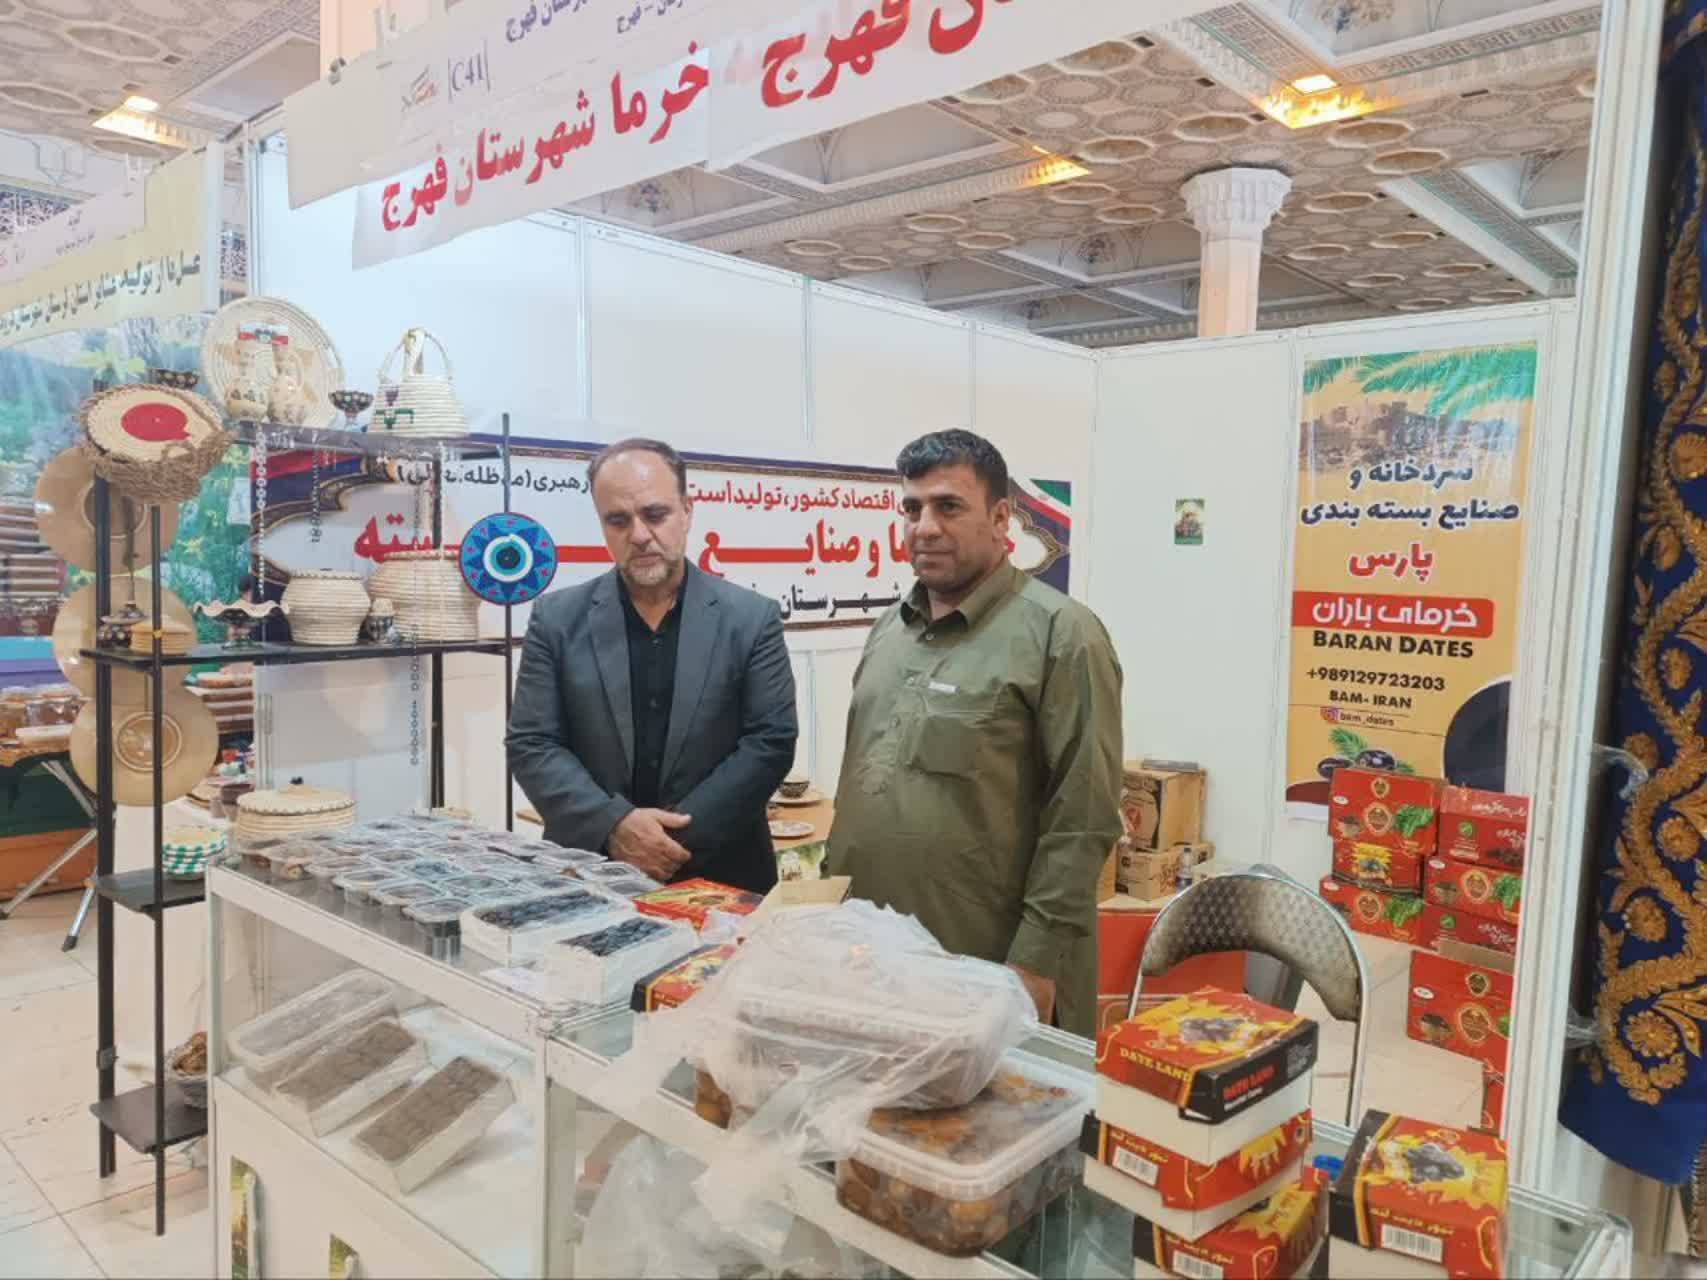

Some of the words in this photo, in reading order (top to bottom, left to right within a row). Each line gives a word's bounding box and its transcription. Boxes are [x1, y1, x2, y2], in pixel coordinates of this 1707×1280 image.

[611, 41, 710, 144] خرما
[455, 89, 595, 207] شهرستان
[382, 144, 448, 232] فهرج
[1350, 469, 1362, 490] و
[1369, 458, 1473, 489] سردخانه
[736, 482, 782, 510] تولید
[1301, 501, 1361, 527] بندی
[1367, 501, 1432, 527] بسته
[1438, 499, 1520, 529] صنایع
[865, 539, 880, 578] و
[1349, 543, 1433, 581] پارس
[1312, 597, 1372, 628] باران
[1377, 601, 1477, 633] خرمای
[1313, 630, 1393, 652] BARAN
[1400, 636, 1474, 659] DATES
[1307, 666, 1446, 691] +989129723203
[1373, 695, 1412, 709] IRAN
[1119, 1047, 1153, 1070] DATE
[1154, 1063, 1194, 1082] LAND
